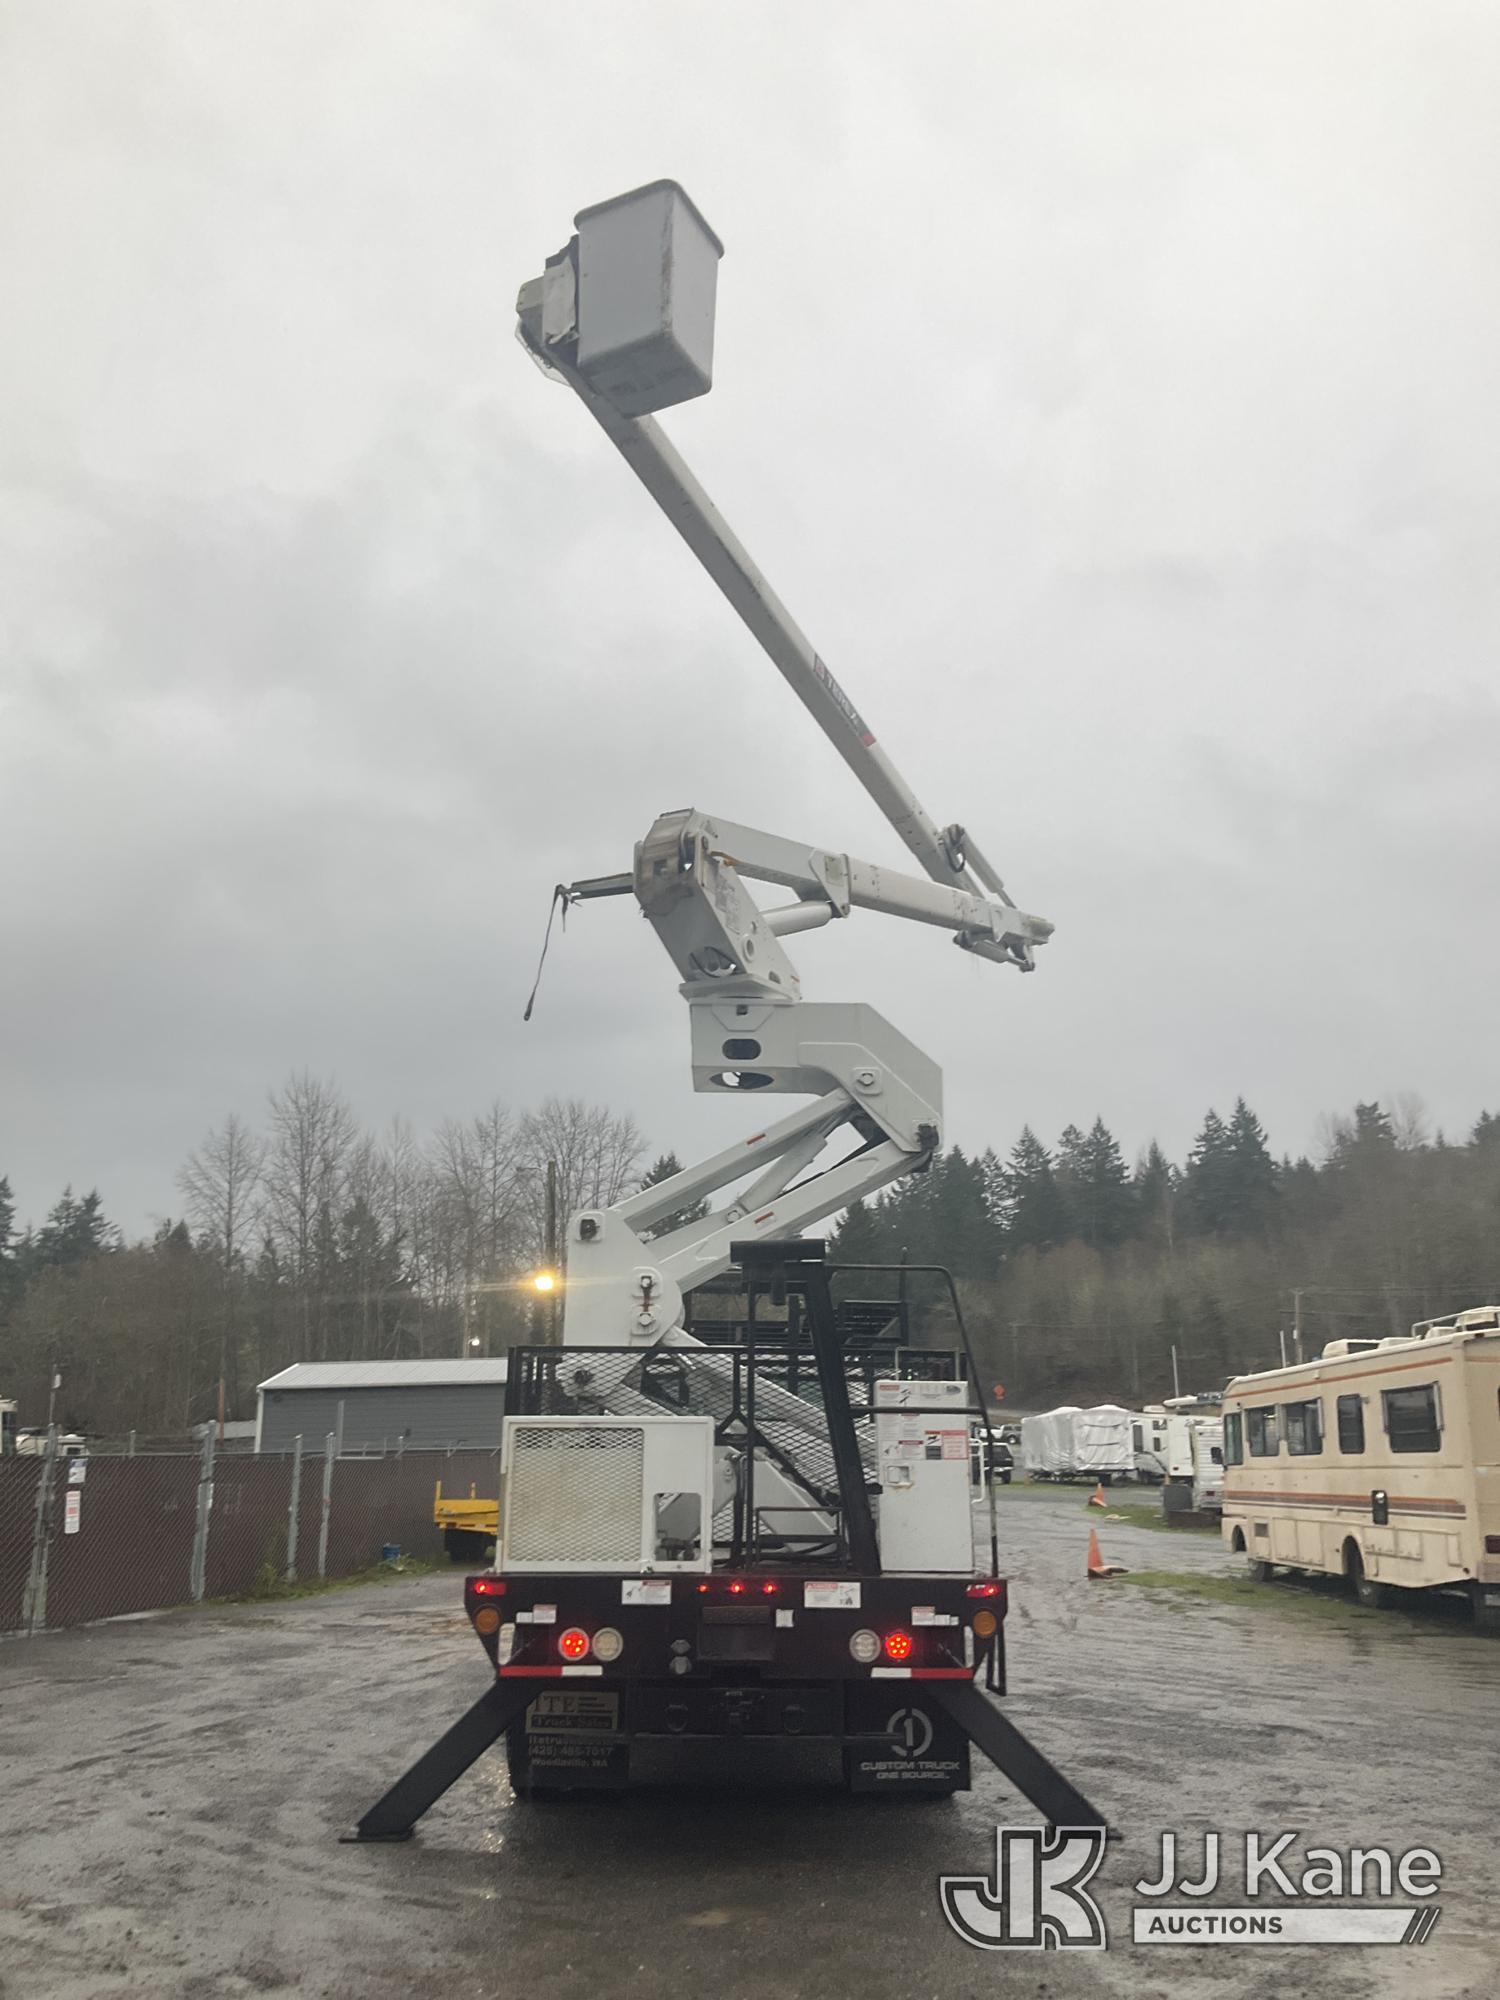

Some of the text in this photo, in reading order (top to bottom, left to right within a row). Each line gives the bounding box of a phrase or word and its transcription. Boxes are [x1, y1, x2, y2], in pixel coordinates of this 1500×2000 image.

[533, 1715, 573, 1727] Truck
[860, 1761, 960, 1771] CUSTOM TRUCK
